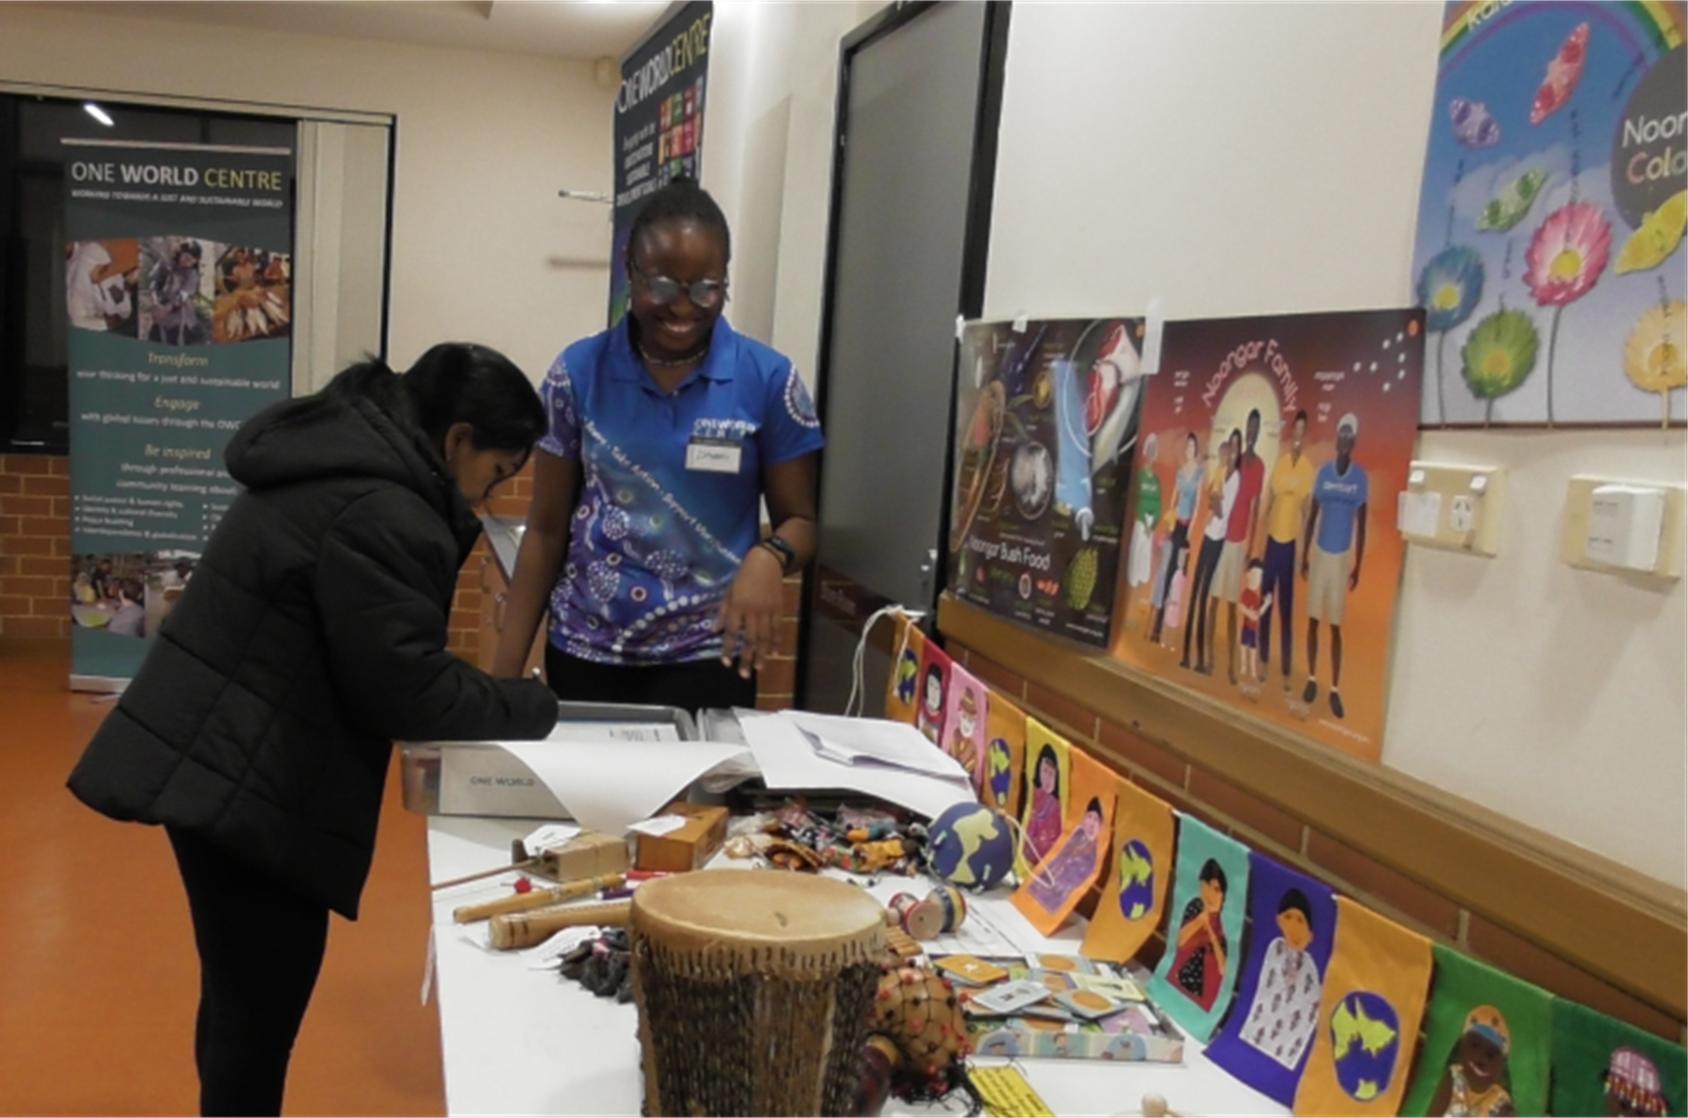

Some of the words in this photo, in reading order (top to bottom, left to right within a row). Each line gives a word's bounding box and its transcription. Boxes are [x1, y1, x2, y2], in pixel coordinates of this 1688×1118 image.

[71, 162, 115, 182] ONE
[120, 164, 199, 186] WORLD
[204, 168, 283, 191] CENTRE
[148, 352, 209, 368] Transform
[99, 370, 136, 382] thinking
[137, 372, 151, 382] for
[160, 375, 178, 385] just
[180, 375, 198, 385] and
[201, 377, 251, 388] sustainable
[252, 379, 280, 389] world
[1202, 340, 1264, 408] Noongar
[1264, 339, 1299, 411] Family
[154, 396, 201, 412] Engage
[81, 412, 101, 422] with
[102, 413, 131, 424] global
[161, 416, 199, 429] through
[201, 419, 215, 429] the
[144, 444, 160, 457] Be
[162, 447, 212, 460] inspired
[121, 462, 157, 474] through
[1000, 542, 1023, 563] Bush
[1024, 547, 1051, 571] Food
[469, 776, 493, 786] ONE
[495, 777, 535, 787] WORLD
